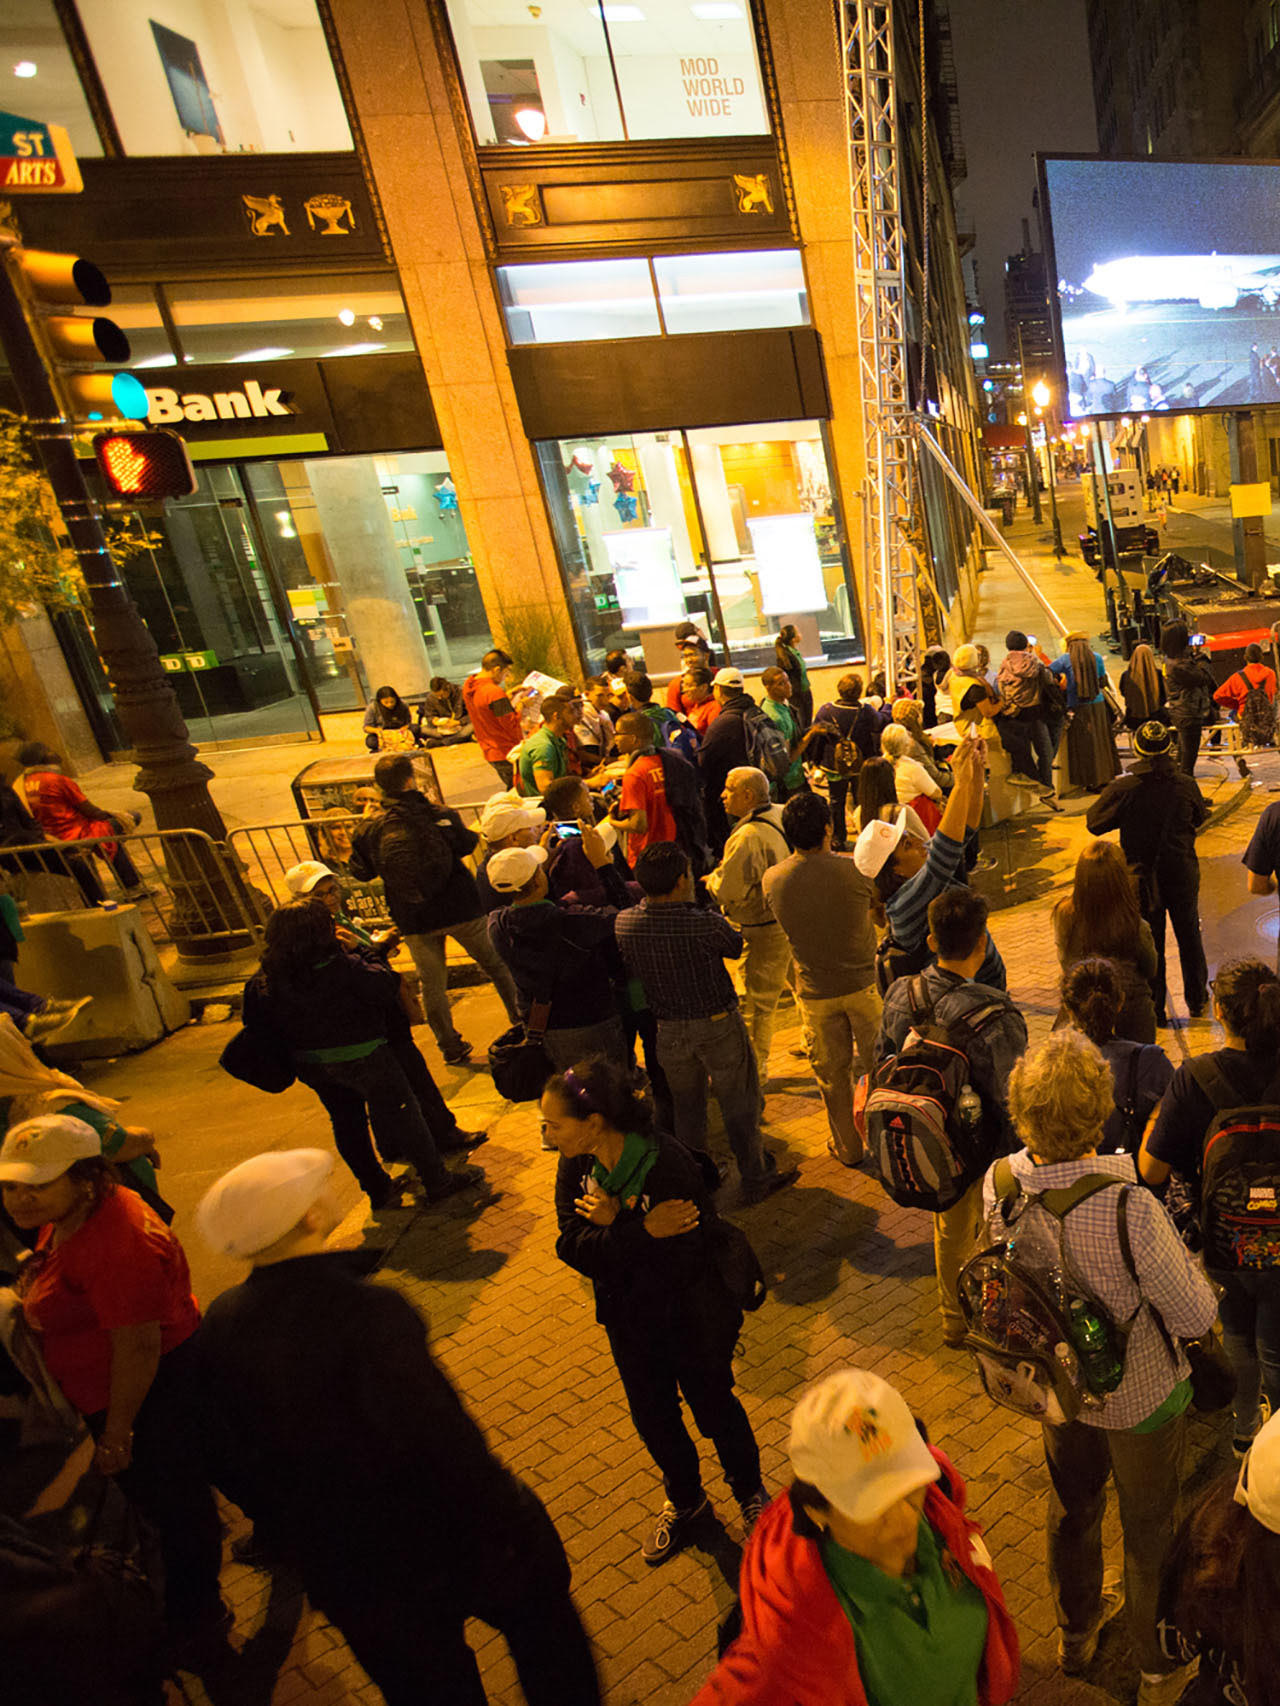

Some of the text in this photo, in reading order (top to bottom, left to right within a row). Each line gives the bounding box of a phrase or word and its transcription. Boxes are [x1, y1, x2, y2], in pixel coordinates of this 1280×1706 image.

[680, 58, 719, 76] MOD
[683, 78, 744, 96] WORLD
[687, 99, 731, 117] WIDE
[12, 132, 44, 156] ST
[5, 160, 56, 185] ARTS
[145, 380, 289, 424] Bank
